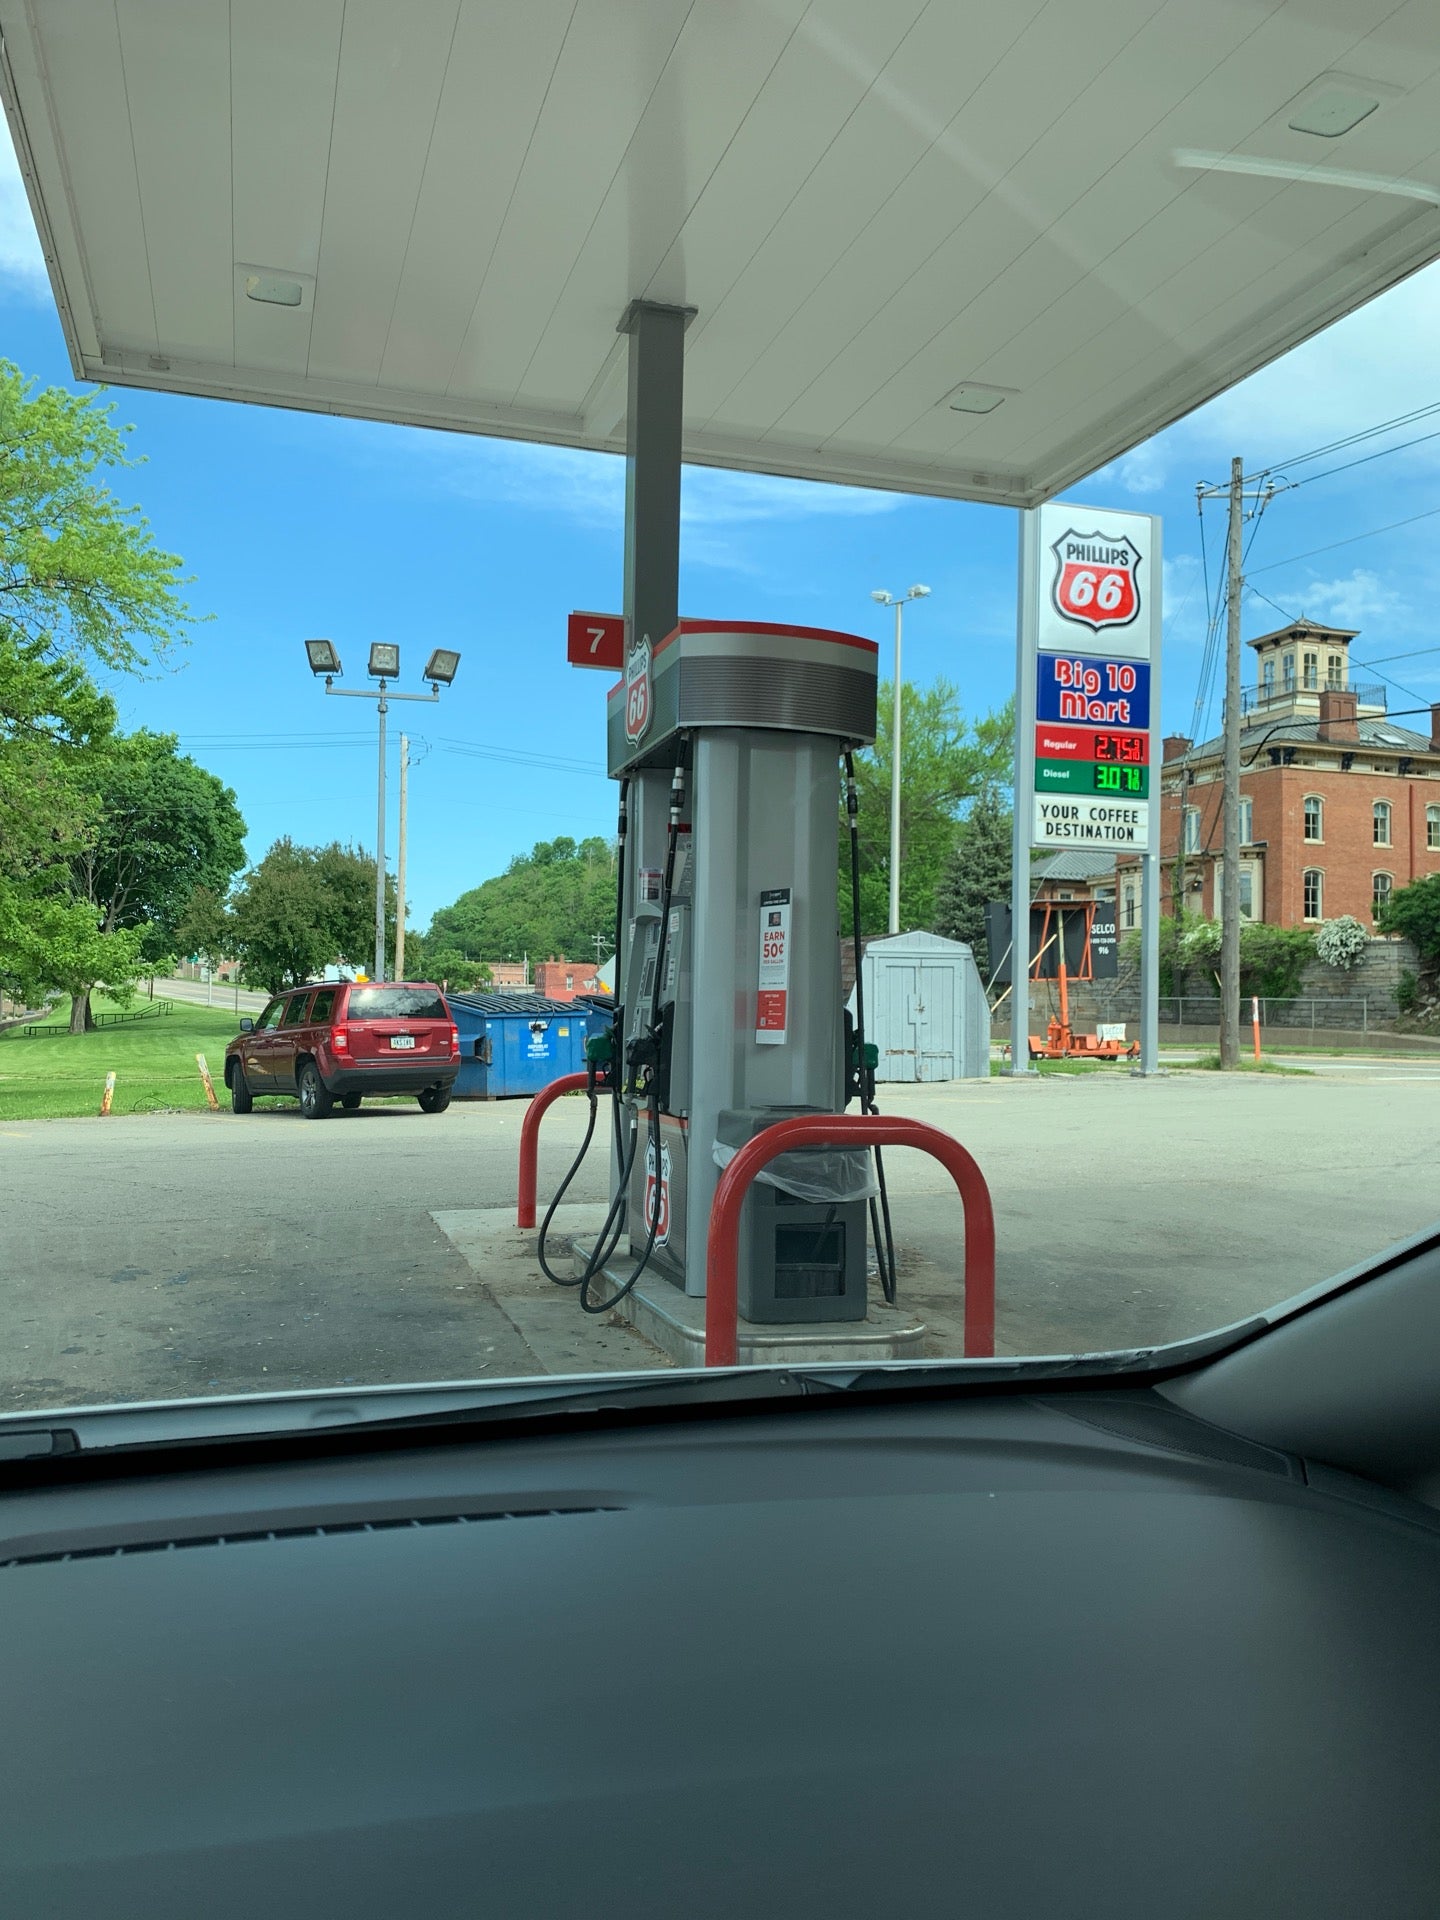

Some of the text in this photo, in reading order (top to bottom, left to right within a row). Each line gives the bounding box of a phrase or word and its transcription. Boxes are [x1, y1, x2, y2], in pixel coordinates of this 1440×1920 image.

[1066, 542, 1129, 566] PHILLIPS
[1069, 570, 1125, 611] 66
[586, 627, 606, 654] 7
[1055, 658, 1136, 696] Big 10
[629, 682, 646, 727] 66
[1060, 690, 1130, 723] Mart
[1043, 738, 1077, 751] Regular
[1043, 768, 1070, 779] Diesel
[1041, 804, 1138, 824] YOUR COFFEE
[1046, 822, 1134, 840] DESTINATION
[764, 931, 785, 942] EARN
[1091, 923, 1116, 935] SELCO
